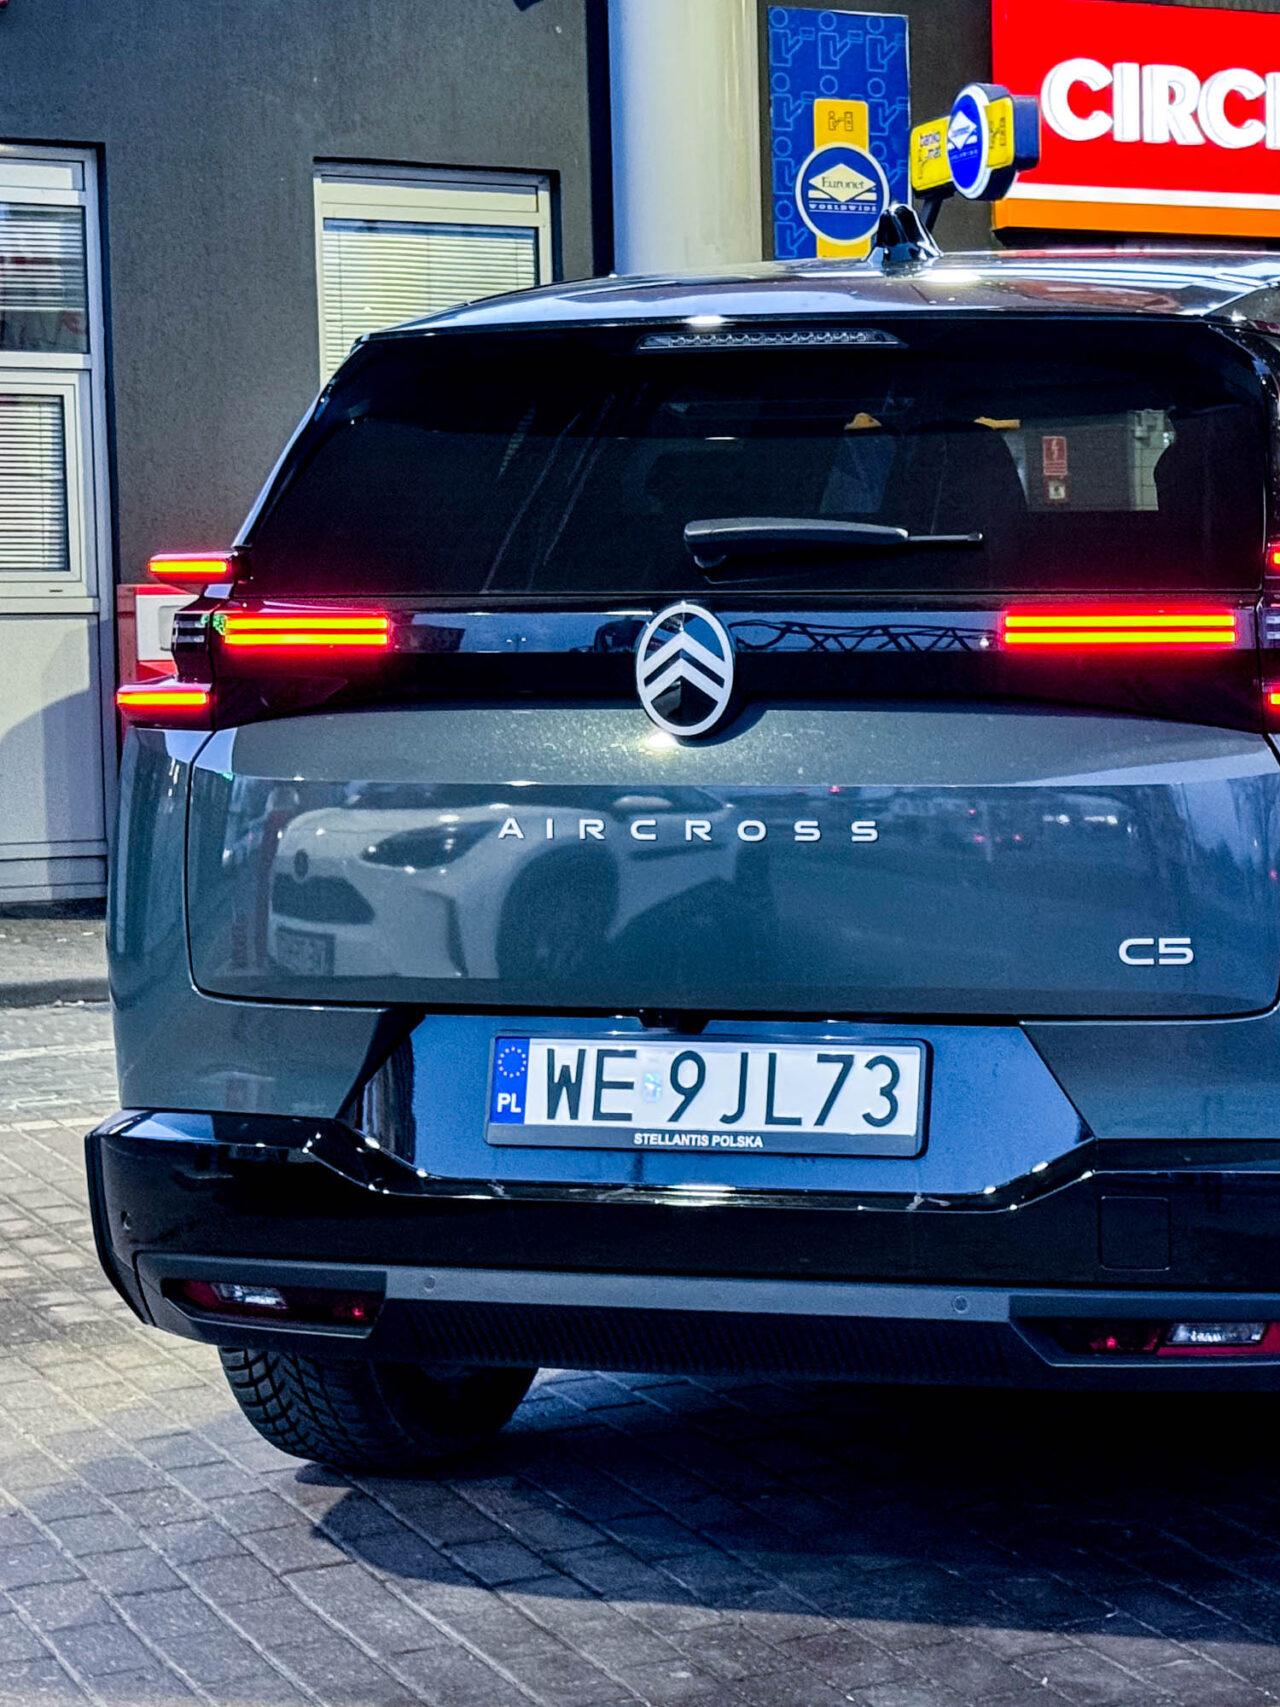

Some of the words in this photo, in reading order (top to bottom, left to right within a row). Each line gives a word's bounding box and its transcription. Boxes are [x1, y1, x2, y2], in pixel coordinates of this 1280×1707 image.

[821, 176, 865, 190] Euronet
[808, 203, 877, 212] WORLDWIDE
[497, 817, 879, 843] AIRCROSS
[1118, 937, 1195, 966] C5
[546, 1047, 638, 1122] WE
[666, 1049, 901, 1128] 9JL73
[496, 1092, 522, 1114] PL
[633, 1132, 709, 1148] STELLANTIS
[711, 1133, 764, 1148] POLSKA
